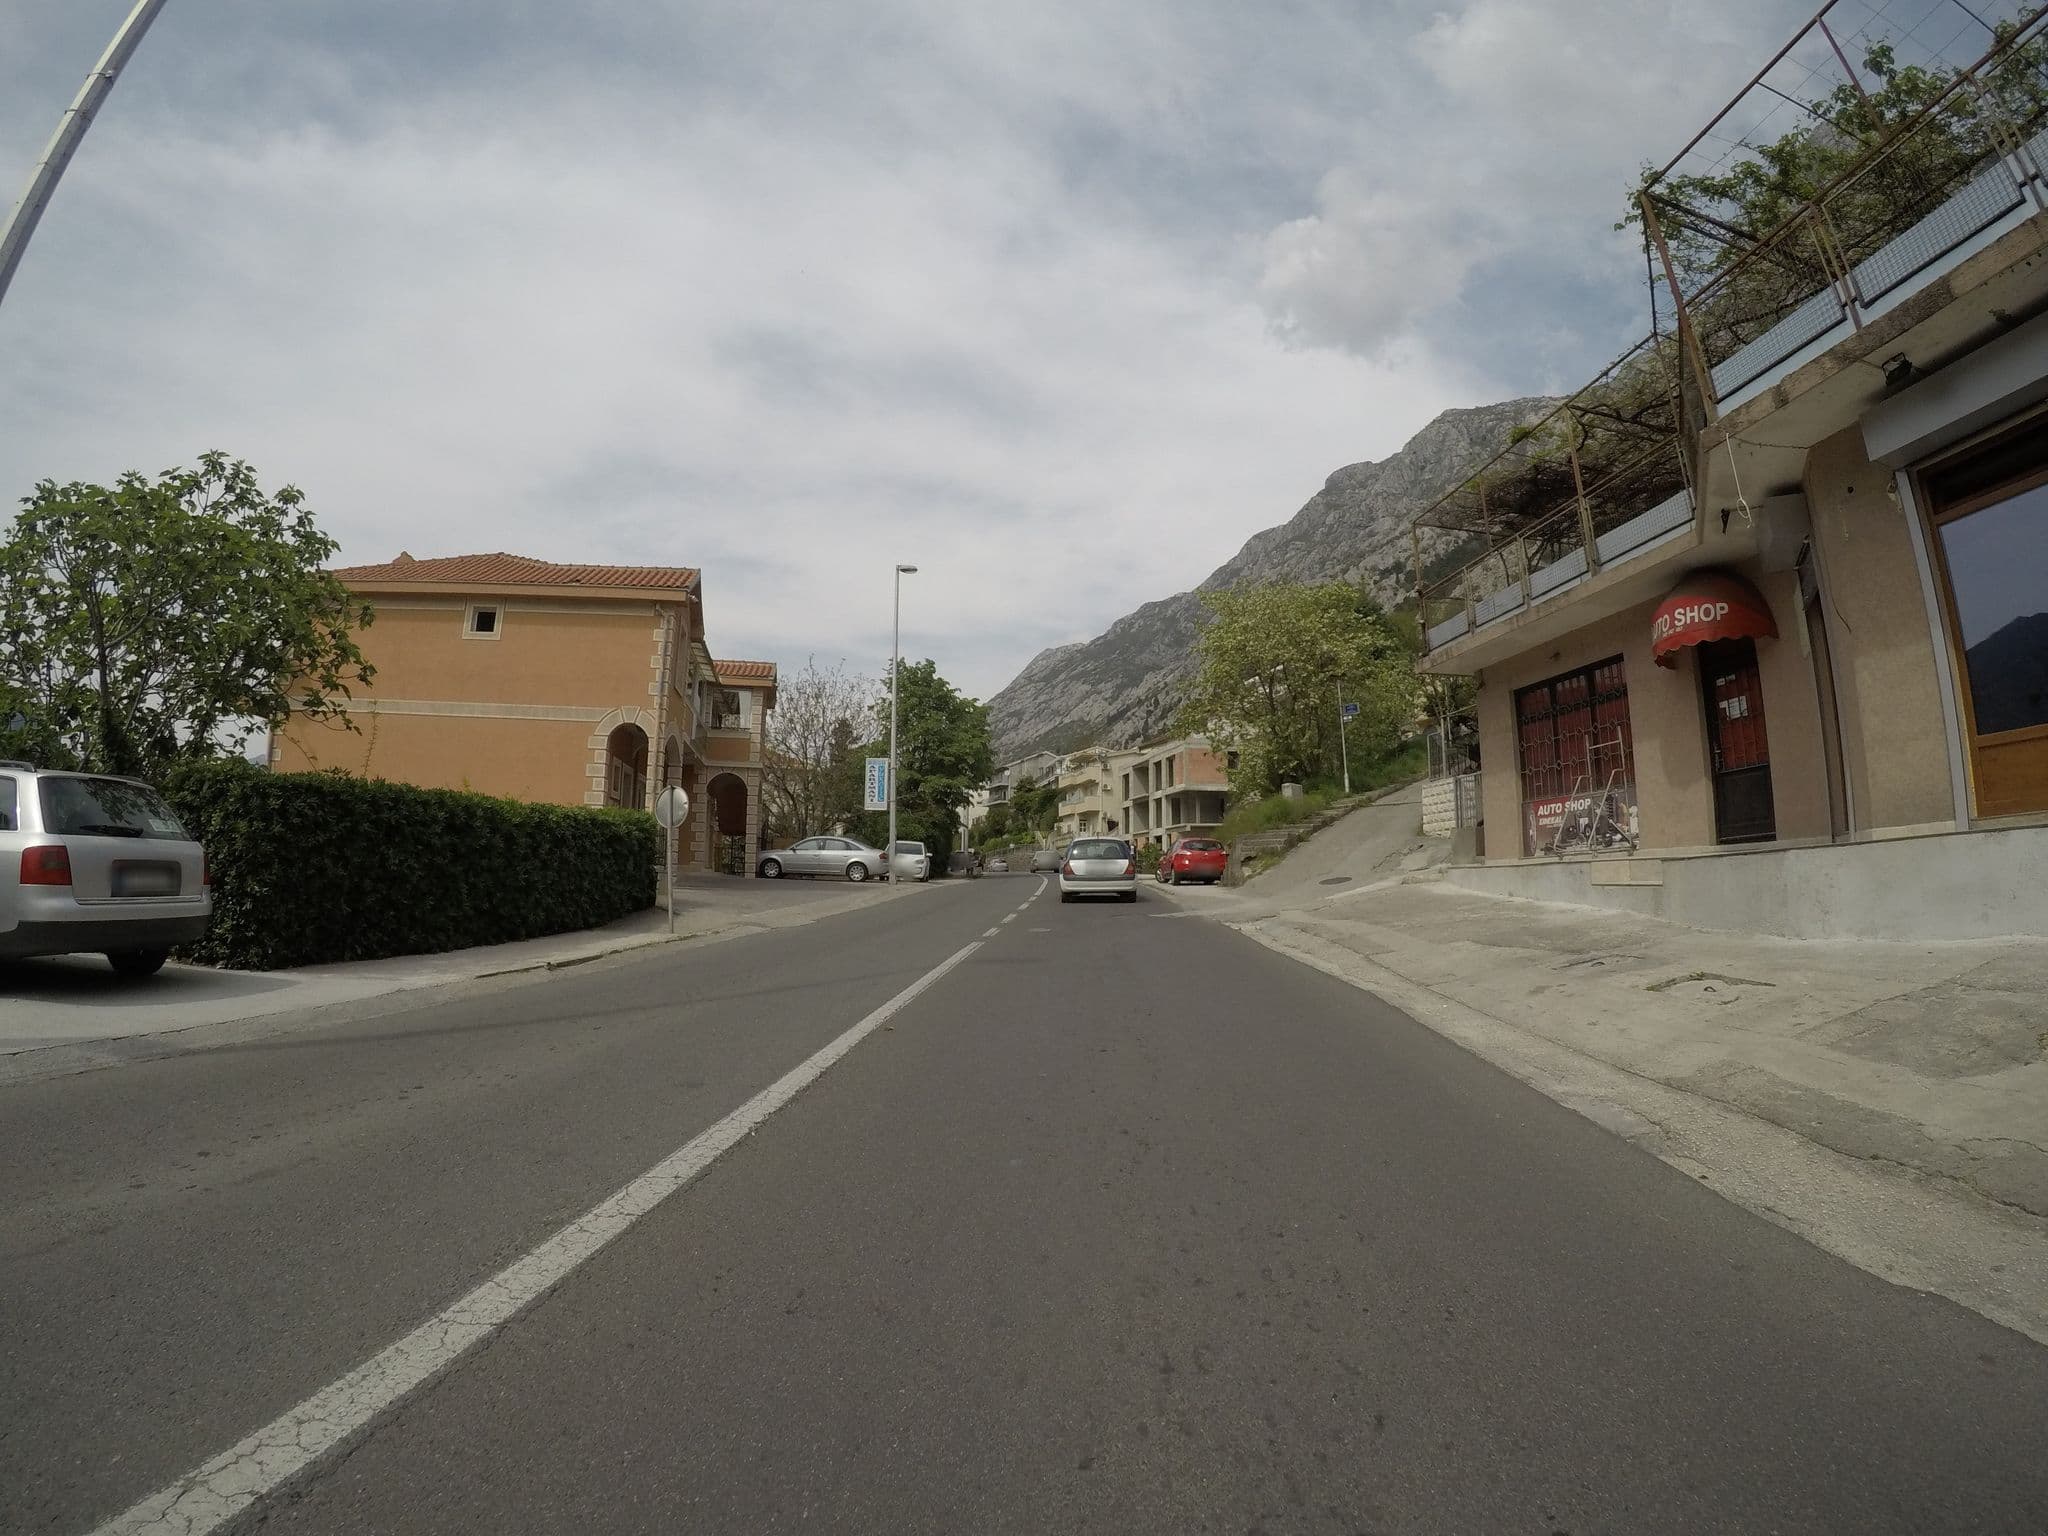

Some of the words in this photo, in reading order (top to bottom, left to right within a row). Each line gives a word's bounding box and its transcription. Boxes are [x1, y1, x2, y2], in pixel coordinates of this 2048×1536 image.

[1674, 602, 1729, 627] SHOP
[1537, 802, 1563, 817] AUTO
[1564, 798, 1591, 811] SHOP
